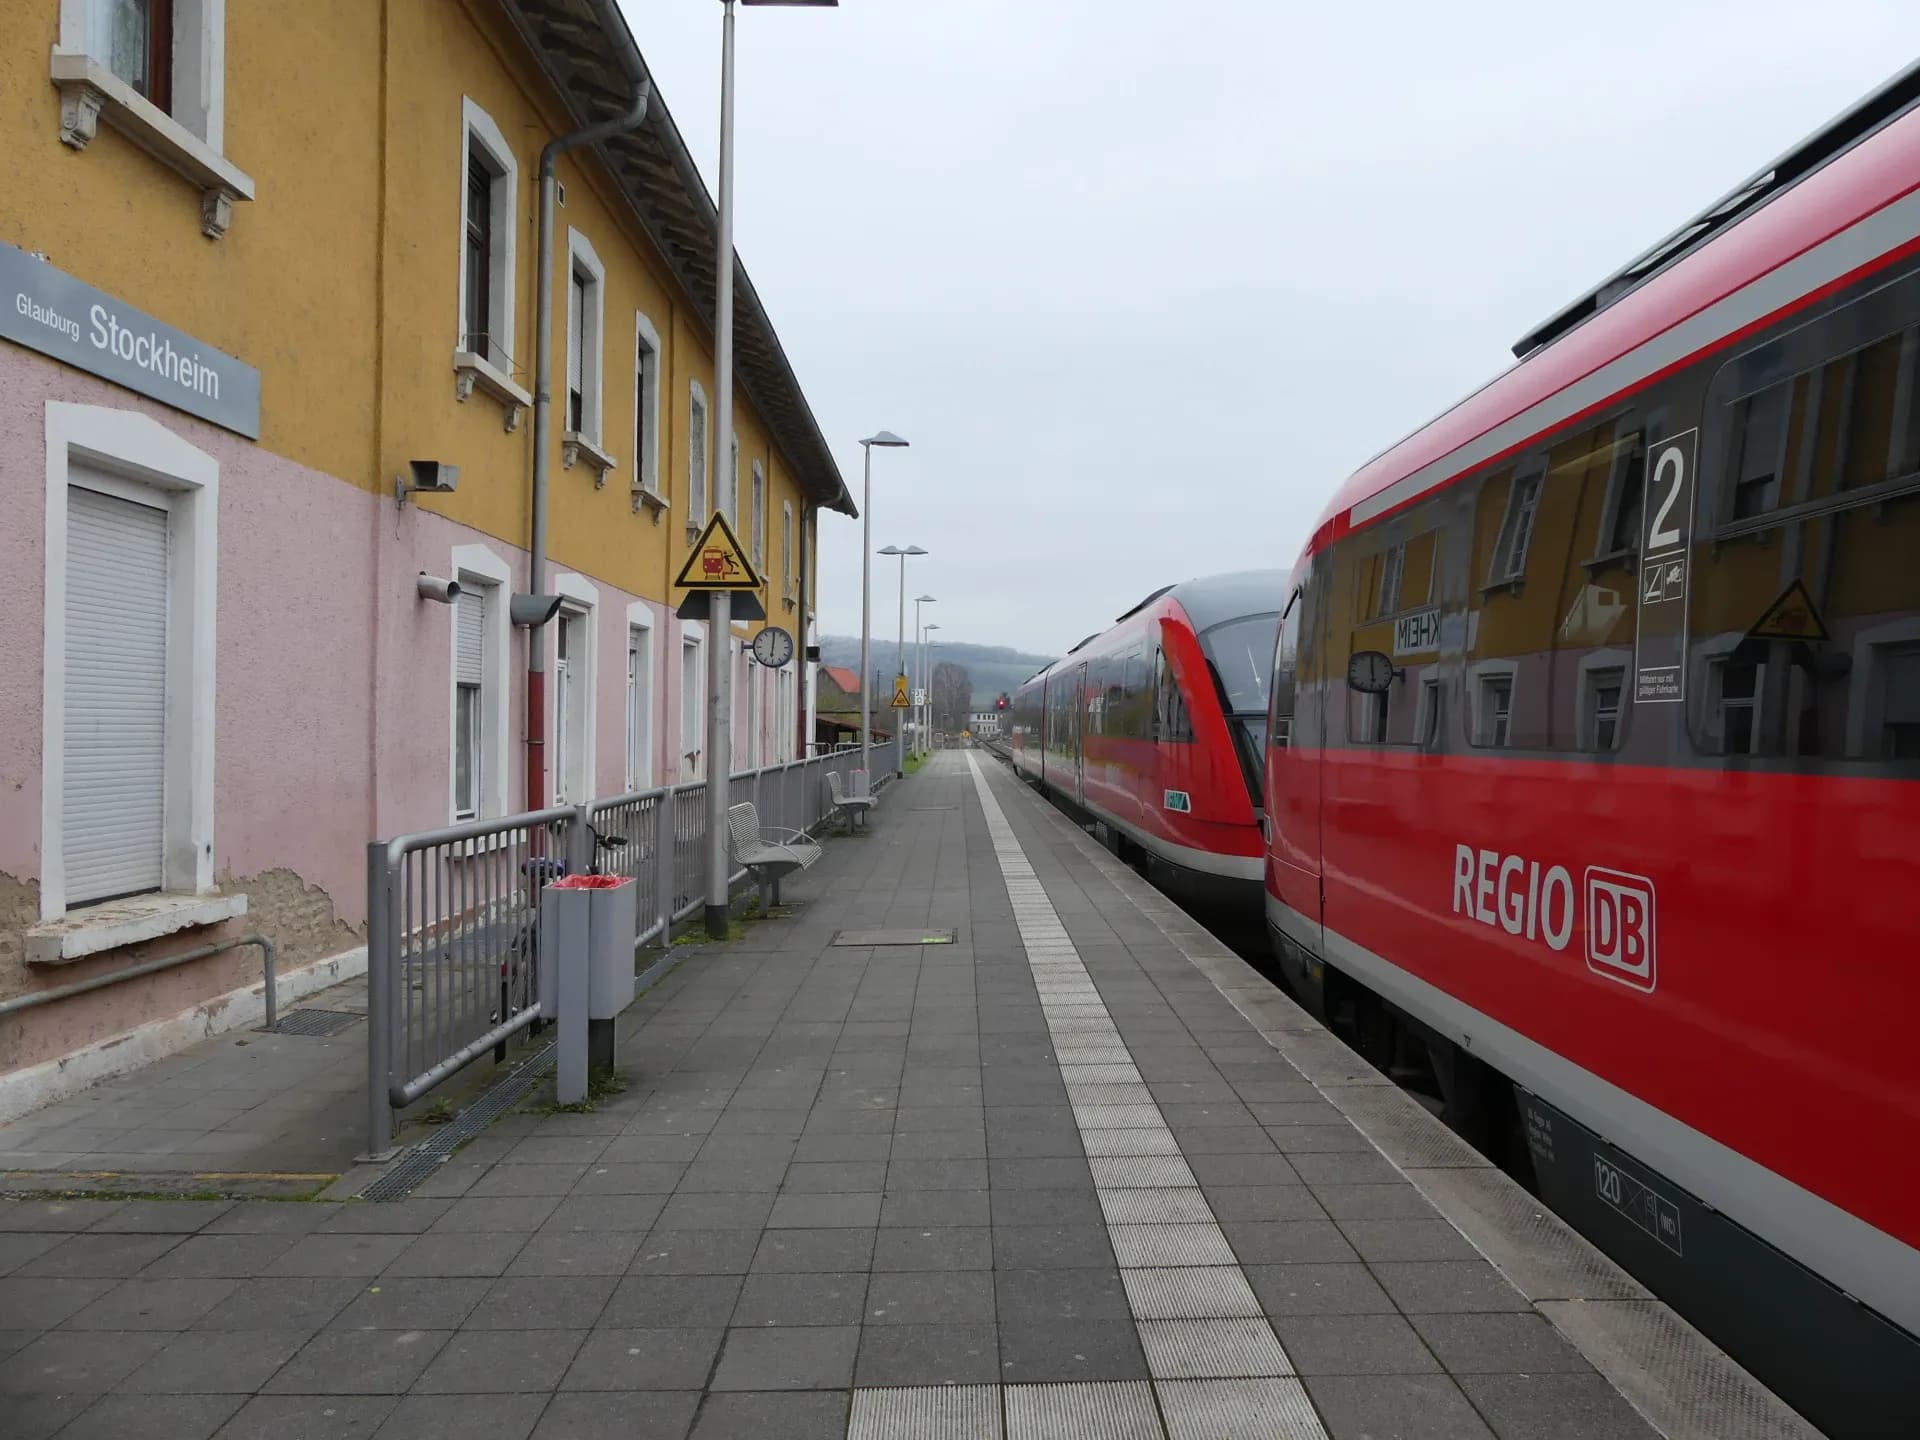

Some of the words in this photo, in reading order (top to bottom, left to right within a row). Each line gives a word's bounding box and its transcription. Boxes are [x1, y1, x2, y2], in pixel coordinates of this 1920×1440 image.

[16, 292, 80, 343] Glauburg
[90, 304, 219, 400] Stockheim
[1648, 446, 1685, 549] 2
[1453, 843, 1575, 951] REGIO
[1593, 885, 1646, 968] DB
[1596, 1160, 1621, 1205] 120
